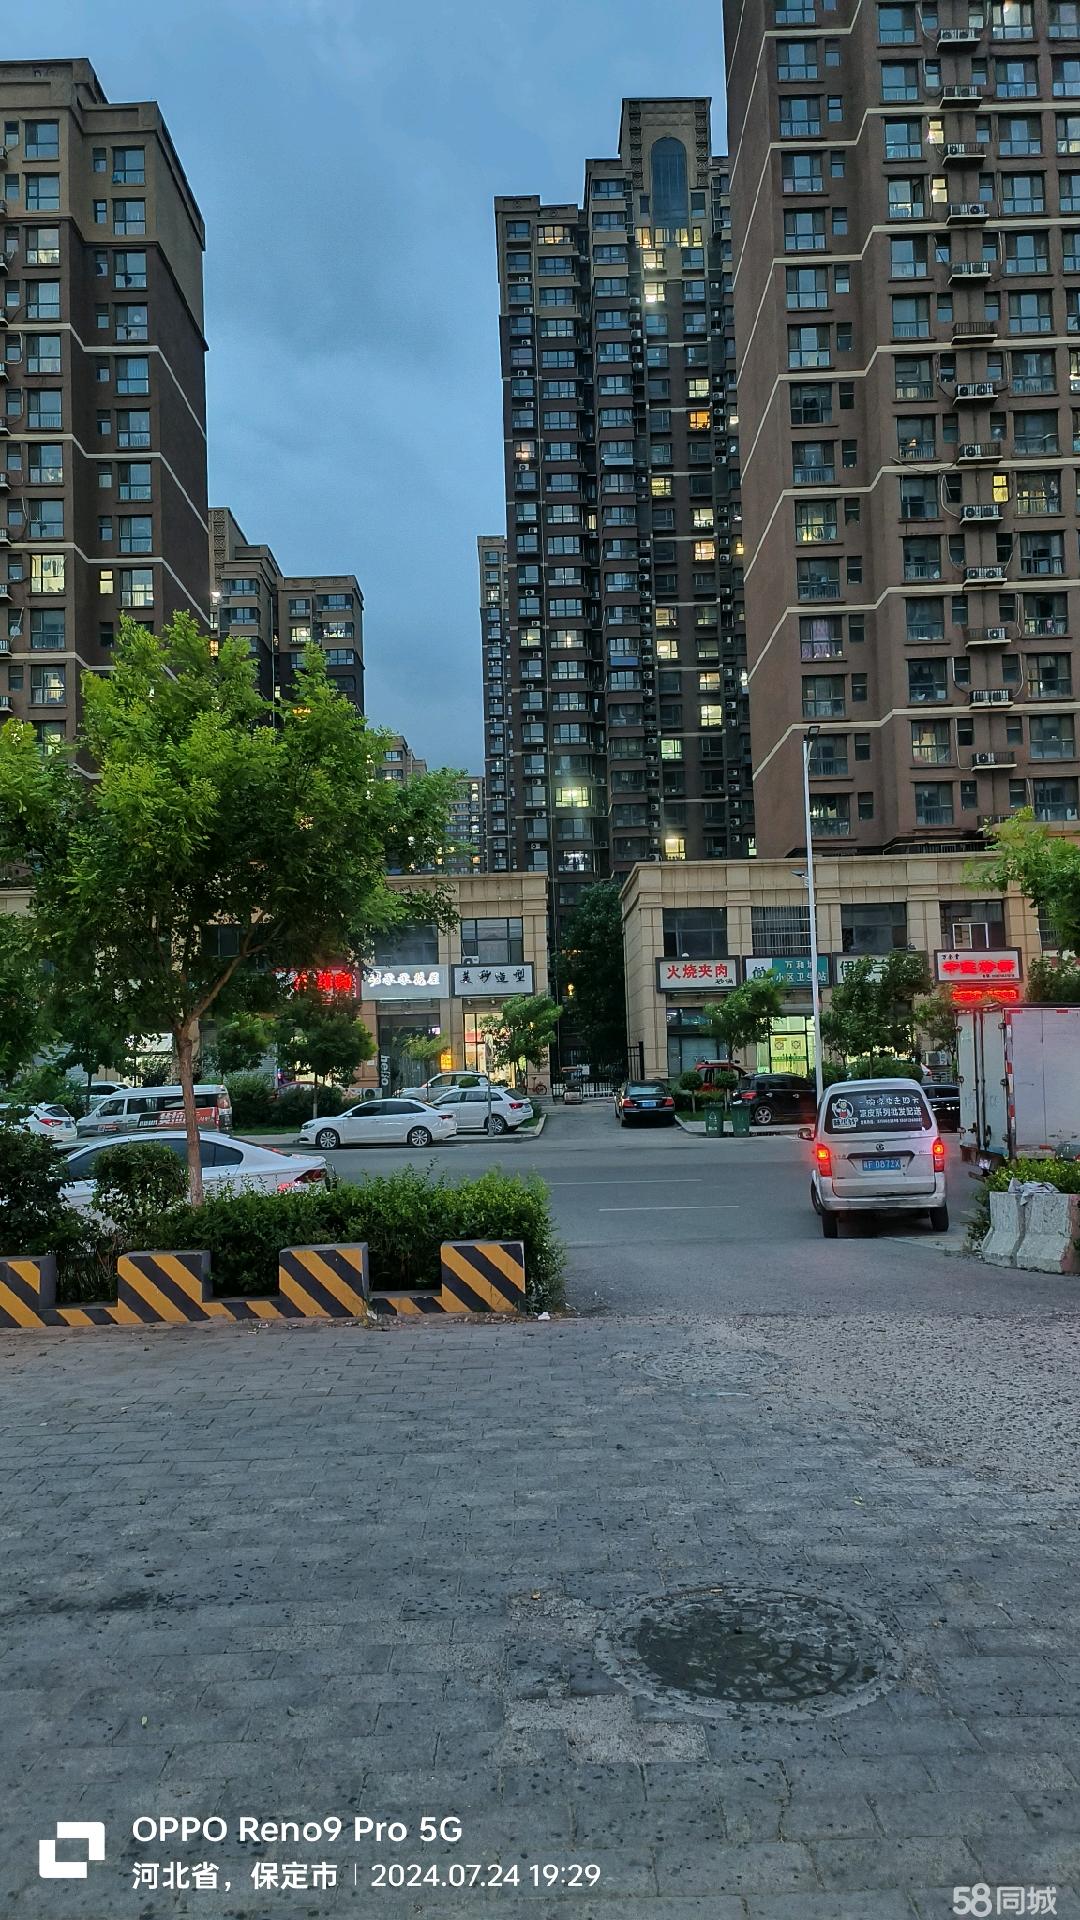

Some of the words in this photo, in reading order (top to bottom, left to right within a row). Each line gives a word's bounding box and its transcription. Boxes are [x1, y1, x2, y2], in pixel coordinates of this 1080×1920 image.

[667, 964, 727, 979] 火烧夹肉
[775, 971, 827, 982] 小区卫生站
